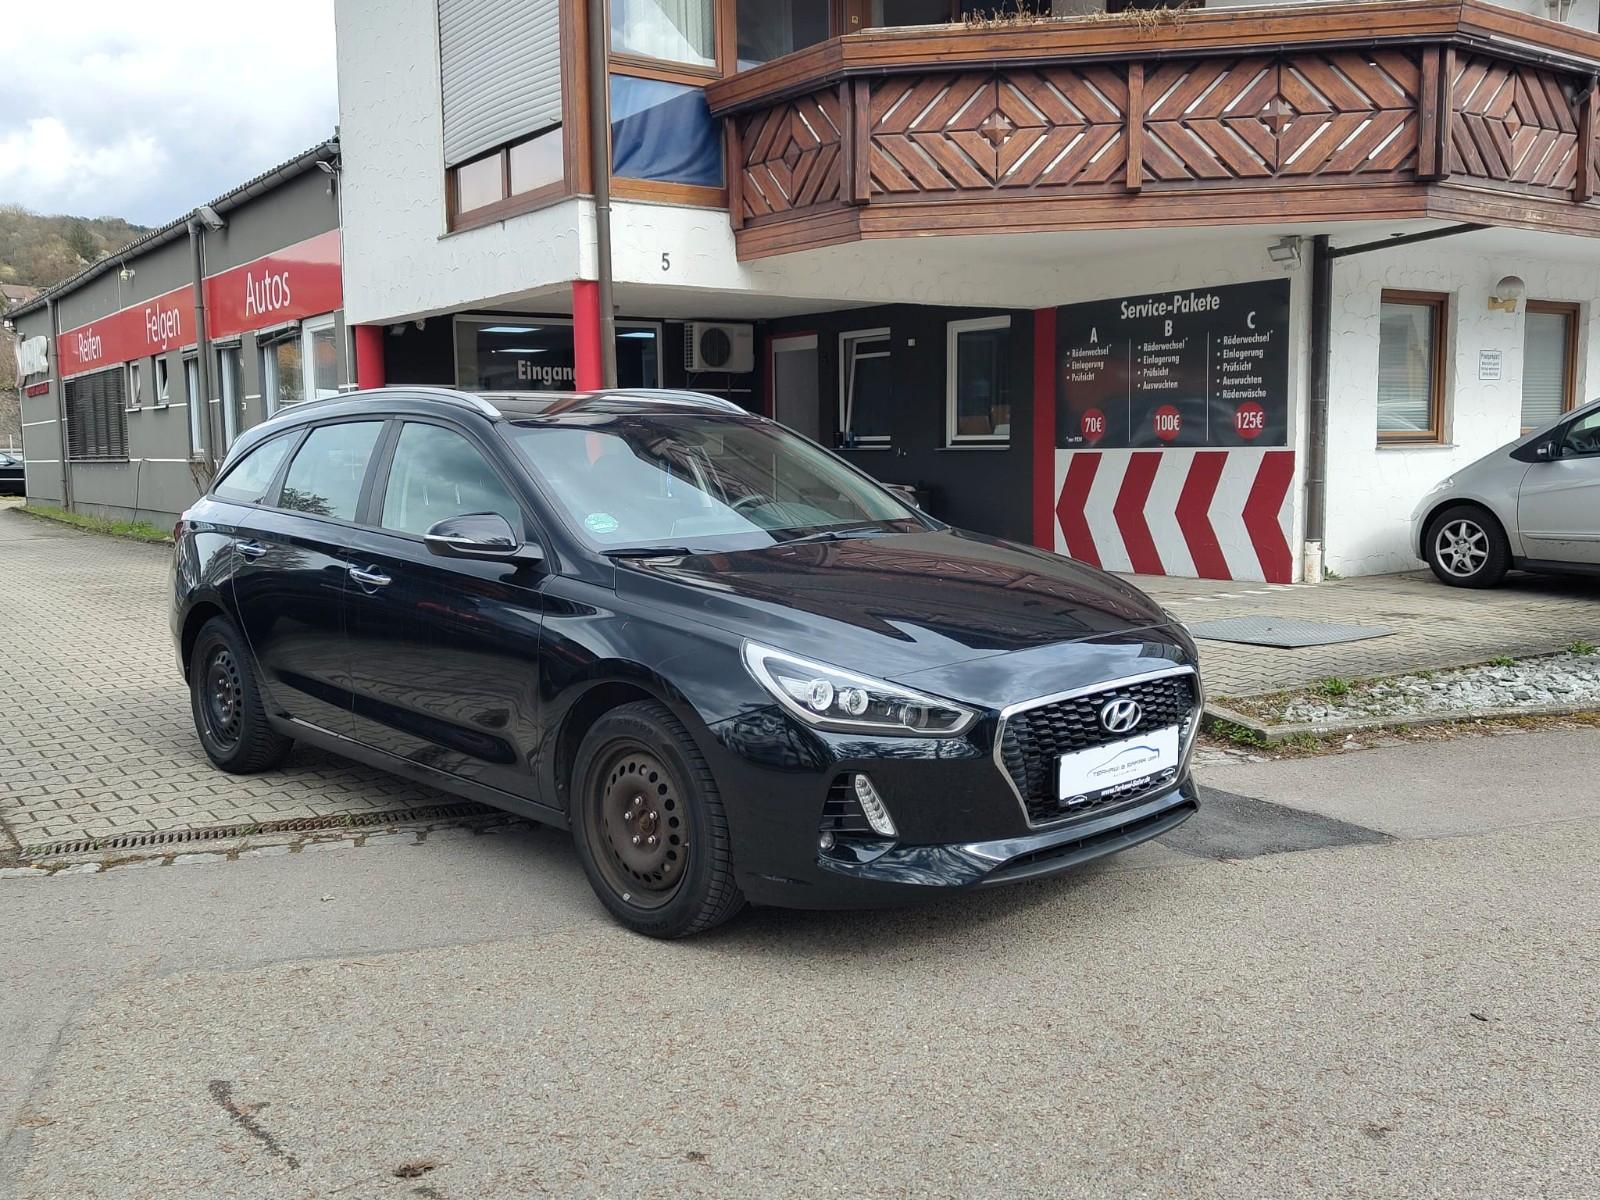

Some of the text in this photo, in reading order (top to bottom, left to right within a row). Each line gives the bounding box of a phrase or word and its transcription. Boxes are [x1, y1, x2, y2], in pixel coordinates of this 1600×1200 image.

[661, 252, 671, 271] 5
[245, 270, 291, 317] Autos
[1120, 292, 1220, 320] Service-Pakete
[145, 304, 181, 350] Felgen
[1164, 319, 1173, 337] B
[1246, 311, 1257, 329] C
[1089, 327, 1098, 344] A
[78, 327, 102, 364] Reifen
[1223, 348, 1264, 360] Einlagerung
[1143, 354, 1180, 366] Einlagerung
[1085, 417, 1102, 433] 70€
[1155, 414, 1180, 431] 100€
[1236, 411, 1264, 429] 125€
